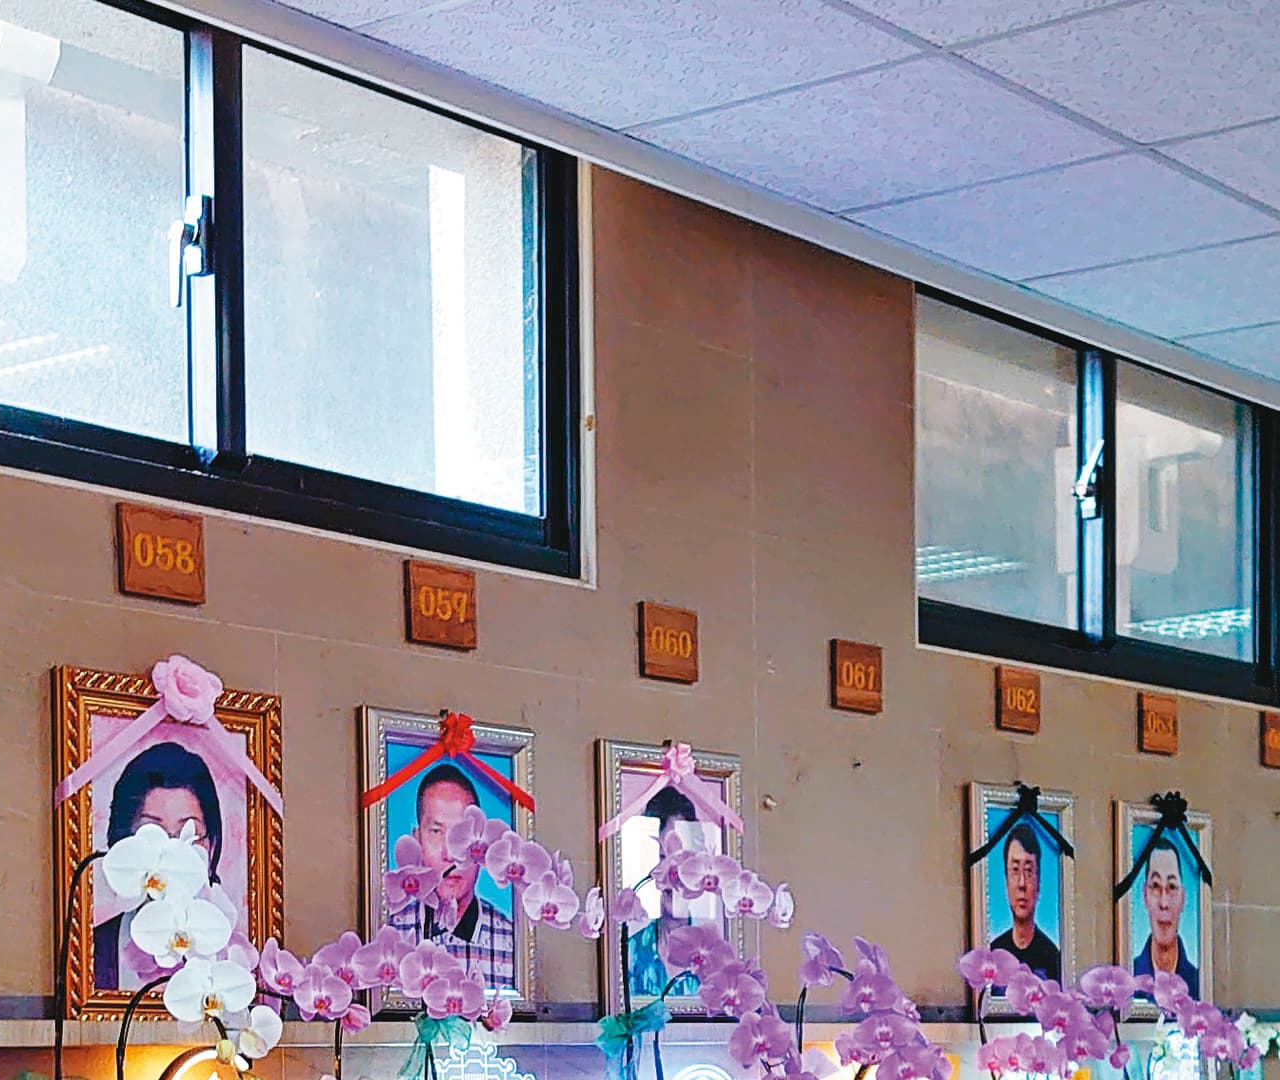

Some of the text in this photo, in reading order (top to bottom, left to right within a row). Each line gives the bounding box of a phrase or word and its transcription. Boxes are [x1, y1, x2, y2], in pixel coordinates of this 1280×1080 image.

[133, 531, 198, 576] 058
[419, 584, 468, 624] 059
[651, 626, 693, 659] 060
[842, 661, 875, 691] 061
[1006, 687, 1037, 715] 062
